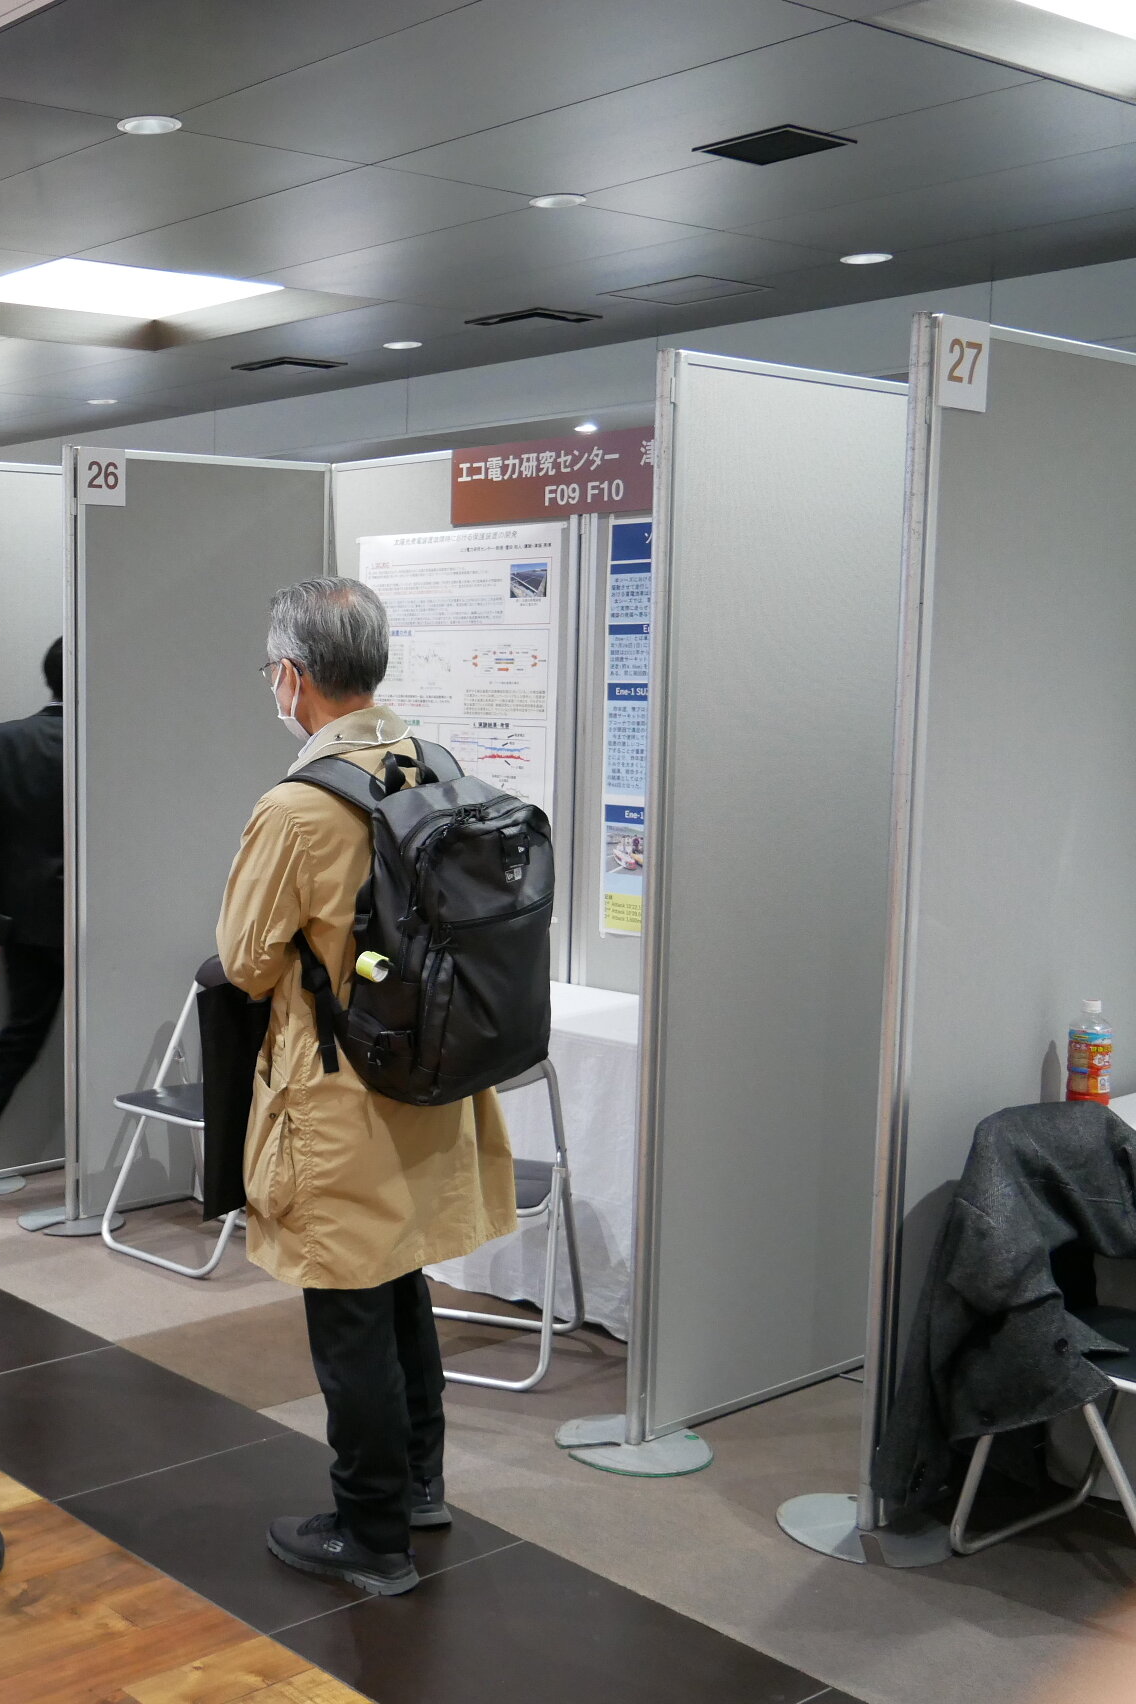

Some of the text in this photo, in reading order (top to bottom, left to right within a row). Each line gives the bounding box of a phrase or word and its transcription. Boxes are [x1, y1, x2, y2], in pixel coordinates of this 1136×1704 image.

[947, 338, 983, 385] 27
[87, 461, 119, 490] 26
[457, 446, 620, 482] エコ電力研究センター
[544, 479, 624, 507] F09 F10
